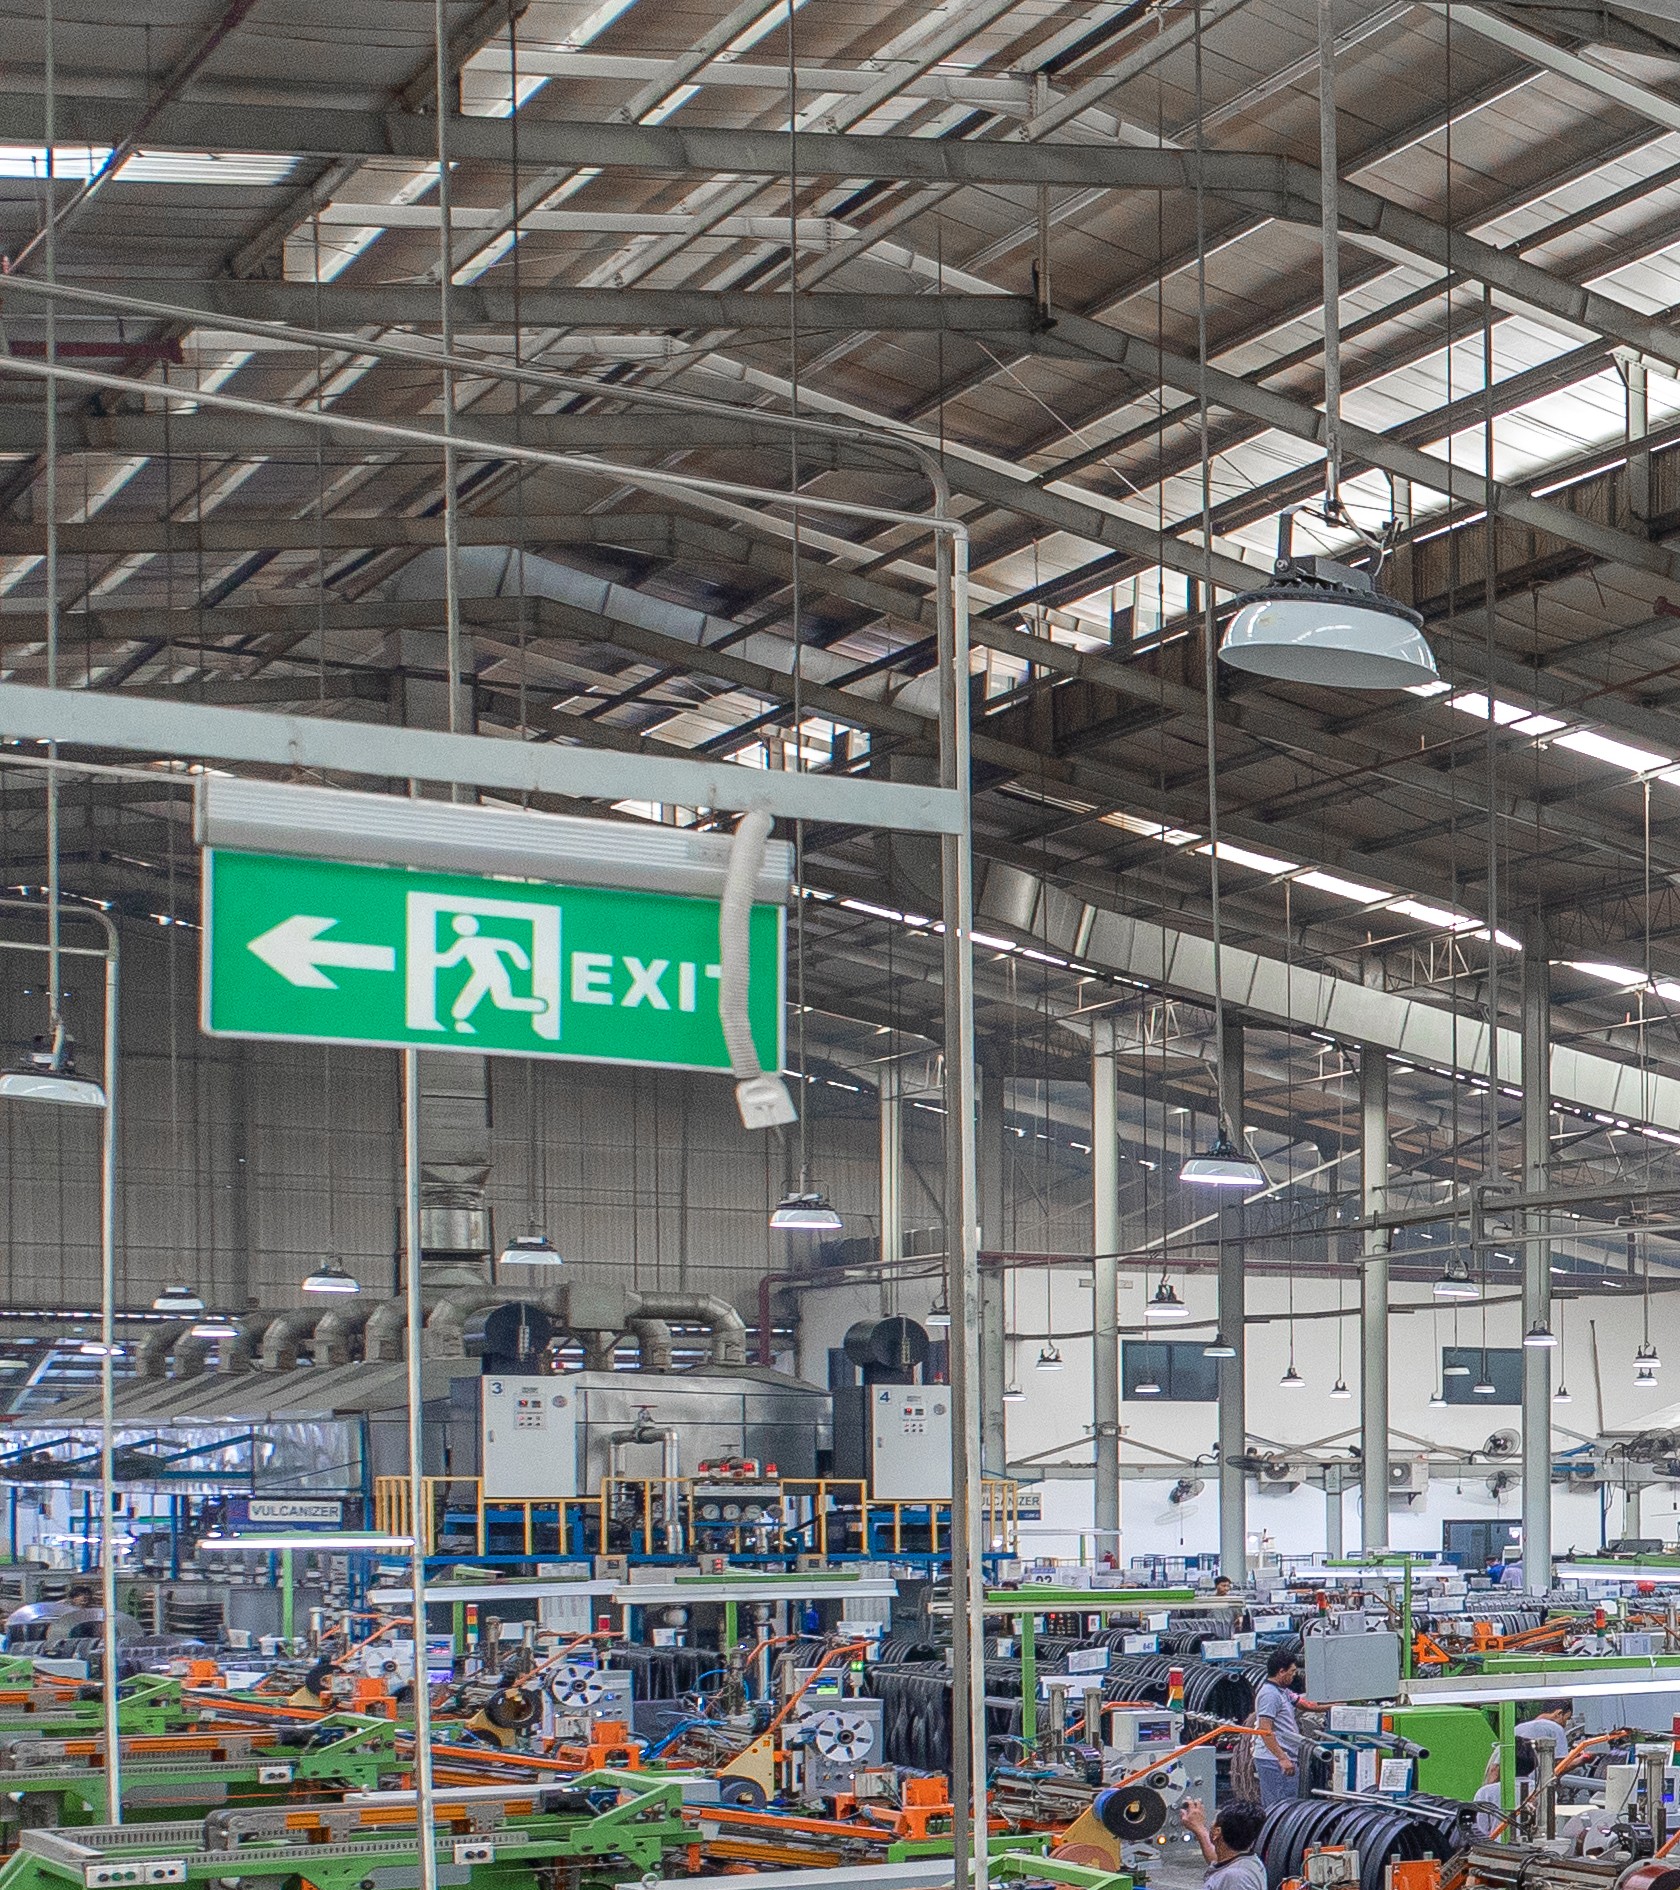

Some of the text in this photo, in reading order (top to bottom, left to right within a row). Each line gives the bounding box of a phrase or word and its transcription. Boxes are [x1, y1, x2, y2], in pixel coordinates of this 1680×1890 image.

[491, 1382, 502, 1394] 3
[879, 1391, 890, 1402] 4
[251, 1503, 339, 1518] VULCANIZER
